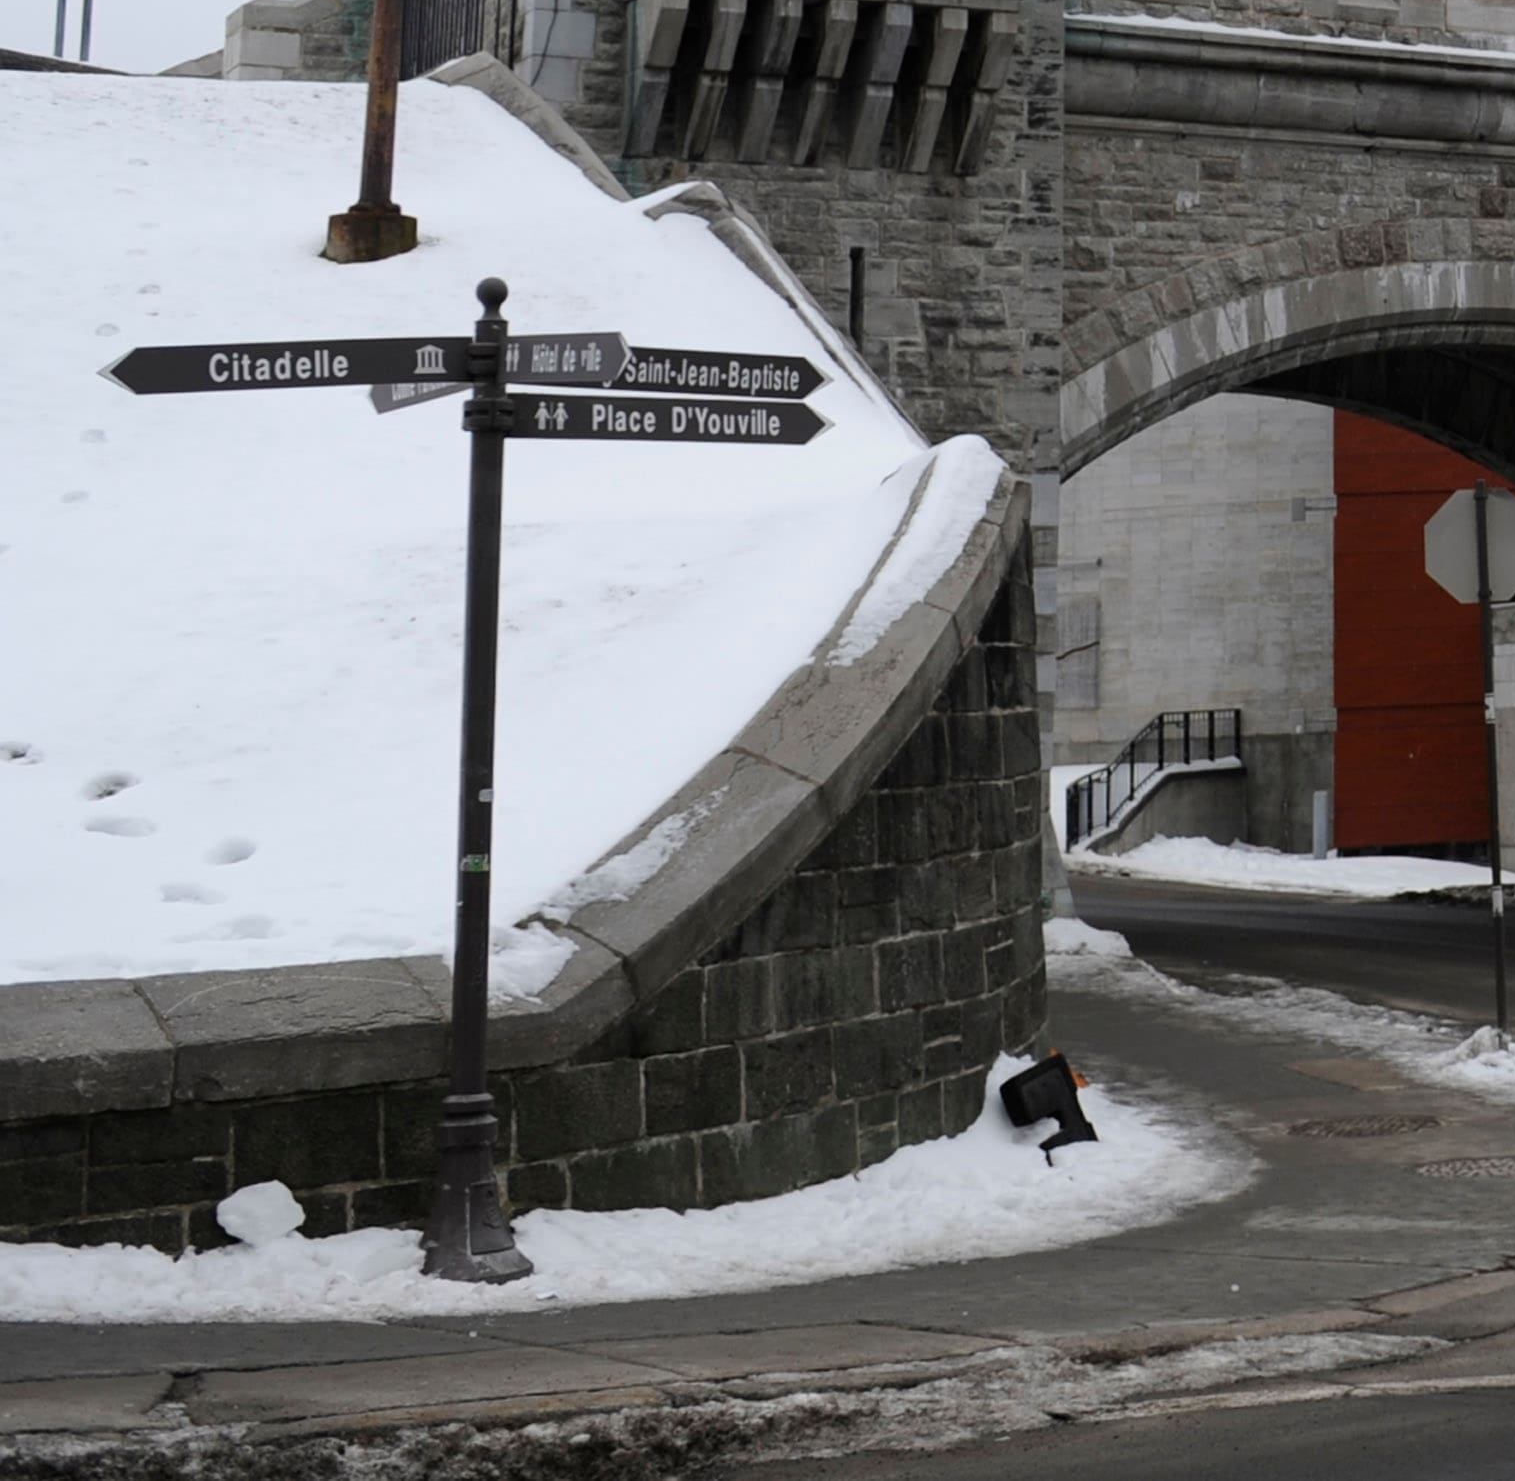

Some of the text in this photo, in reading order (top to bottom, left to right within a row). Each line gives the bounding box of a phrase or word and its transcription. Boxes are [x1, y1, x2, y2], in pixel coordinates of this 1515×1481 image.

[208, 348, 349, 383] Citadelle
[563, 342, 577, 373] de
[626, 355, 800, 396] Saint-Jean-Baptiste
[591, 403, 781, 436] Place D'Youville
